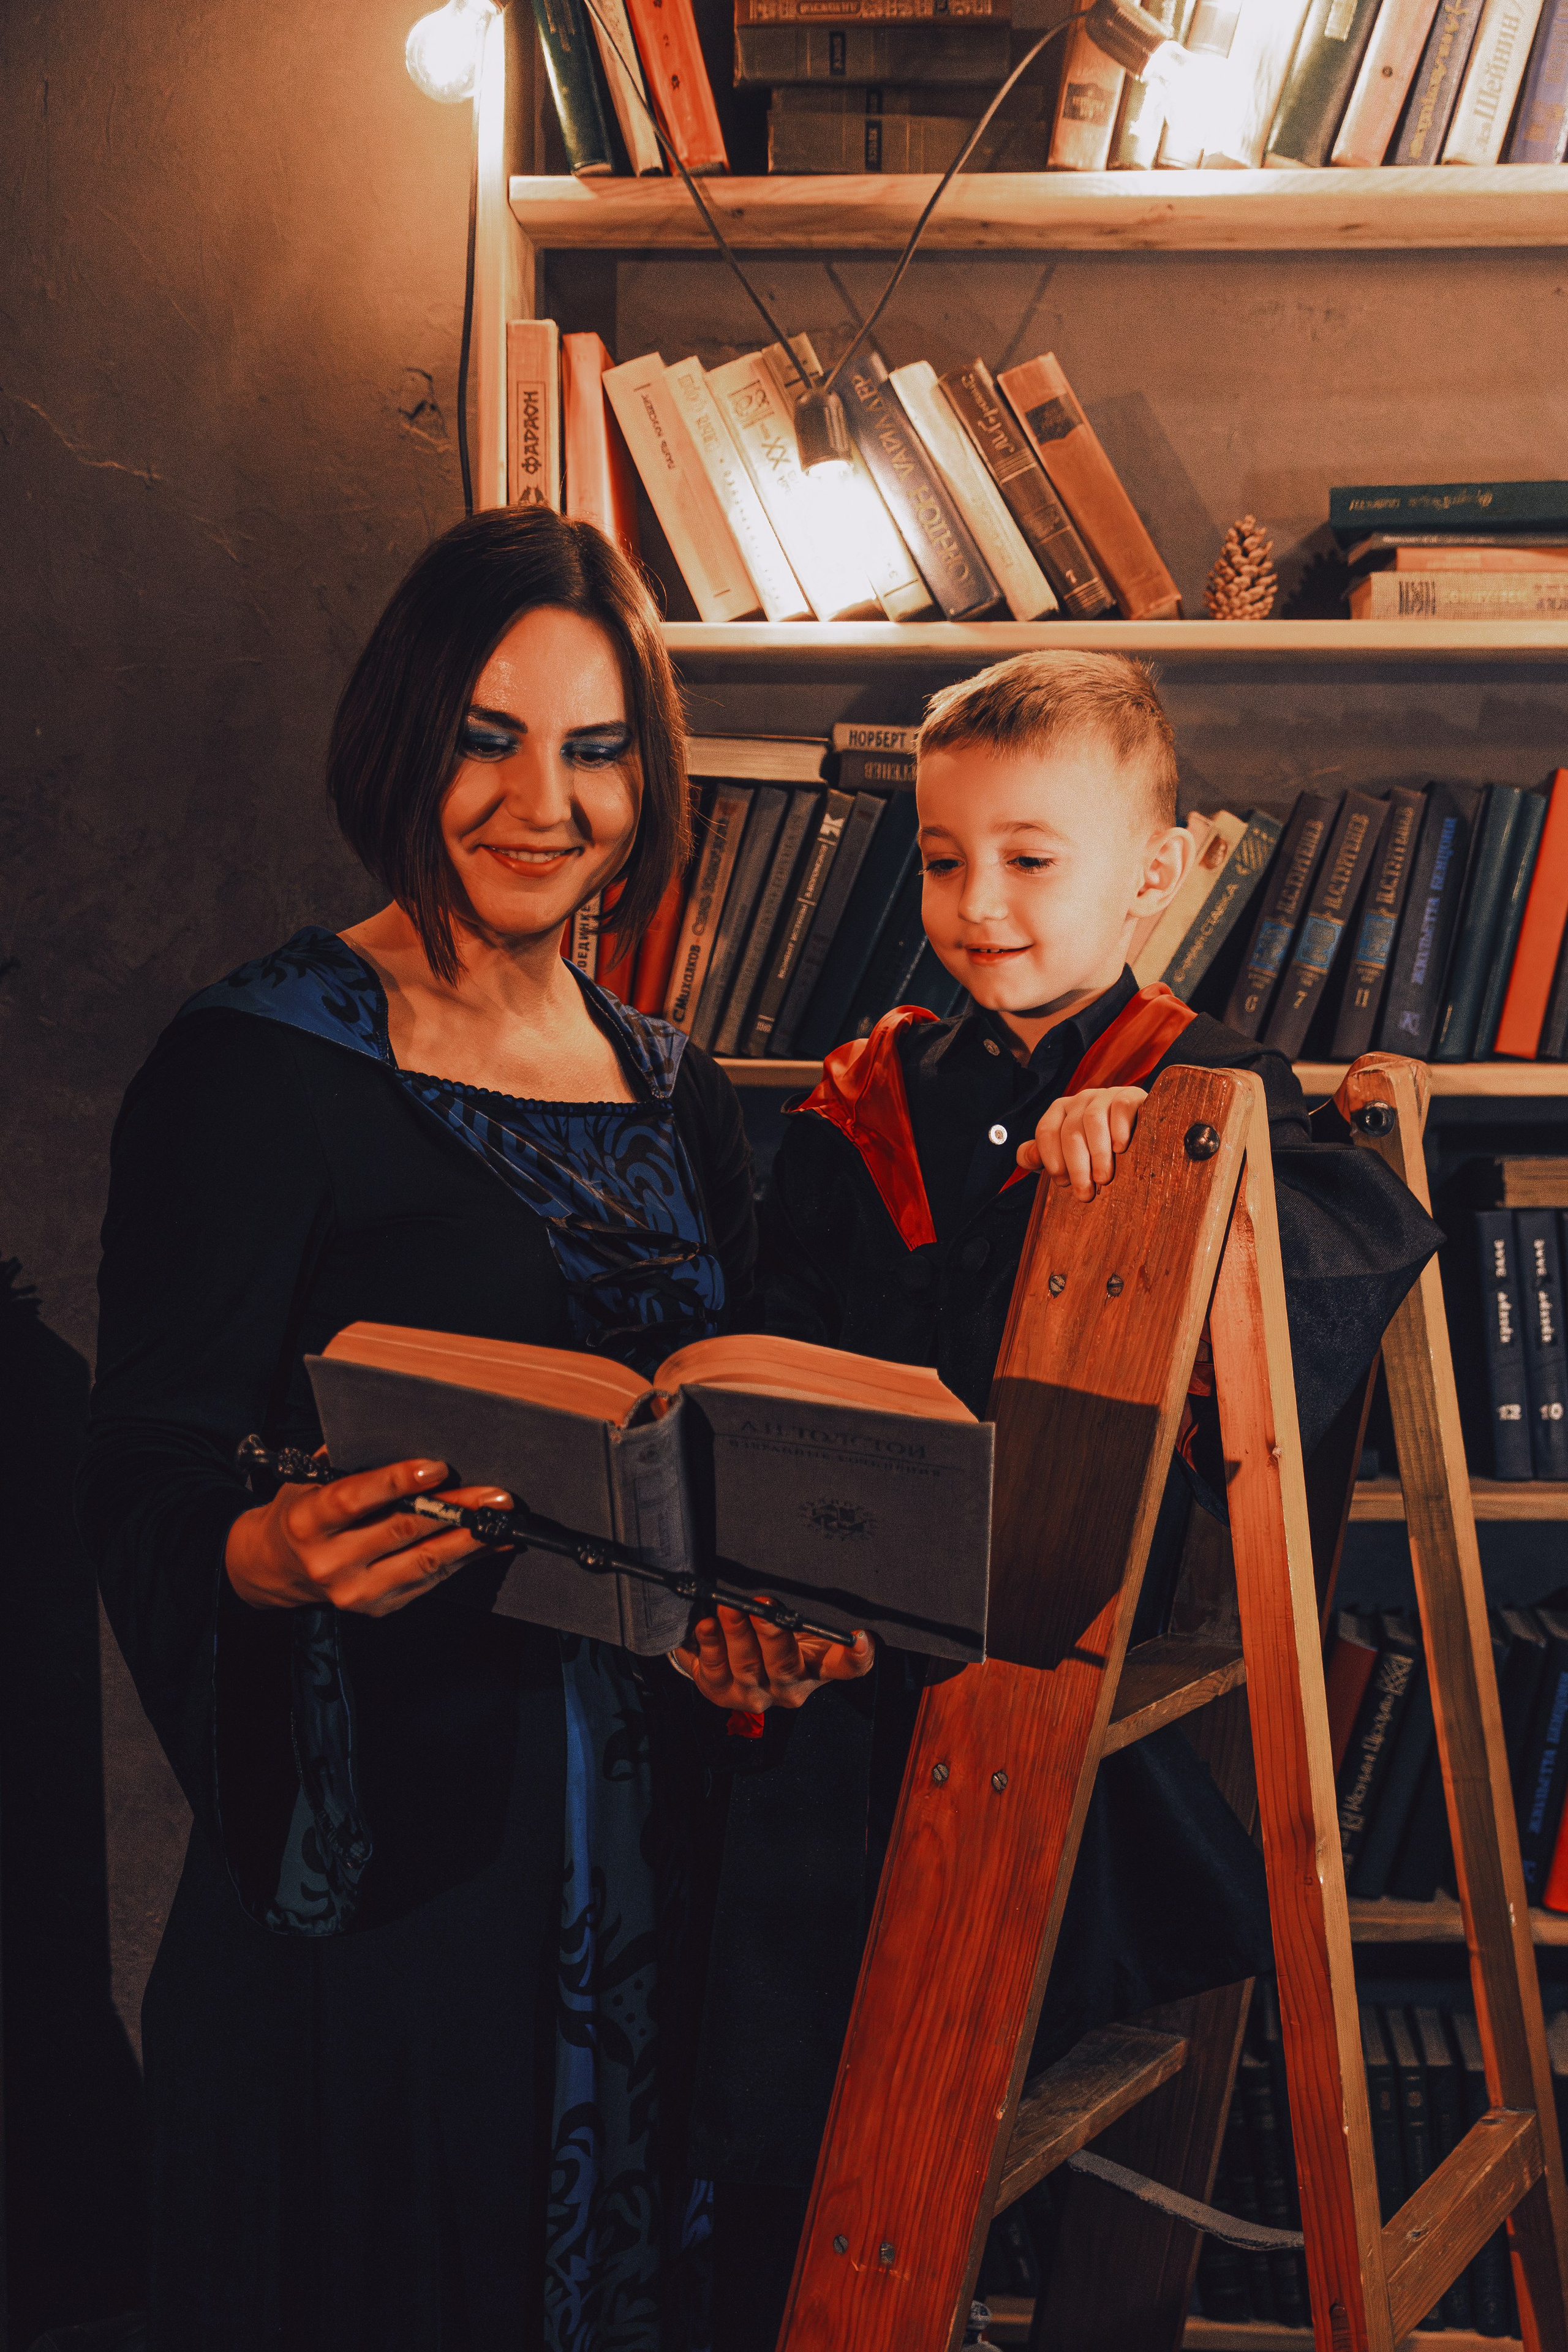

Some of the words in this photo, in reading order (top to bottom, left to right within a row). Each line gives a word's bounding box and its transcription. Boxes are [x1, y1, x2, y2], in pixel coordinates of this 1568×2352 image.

[1473, 12, 1520, 120] Шейнин
[522, 391, 542, 475] ФАРАОН
[849, 729, 907, 748] НОРБЕРТ
[1200, 884, 1239, 937] СТАВКА
[577, 905, 591, 973] ОЕДИНКЕ
[1245, 995, 1259, 1012] 6
[1293, 990, 1308, 1009] 7
[1539, 1401, 1564, 1421] 10
